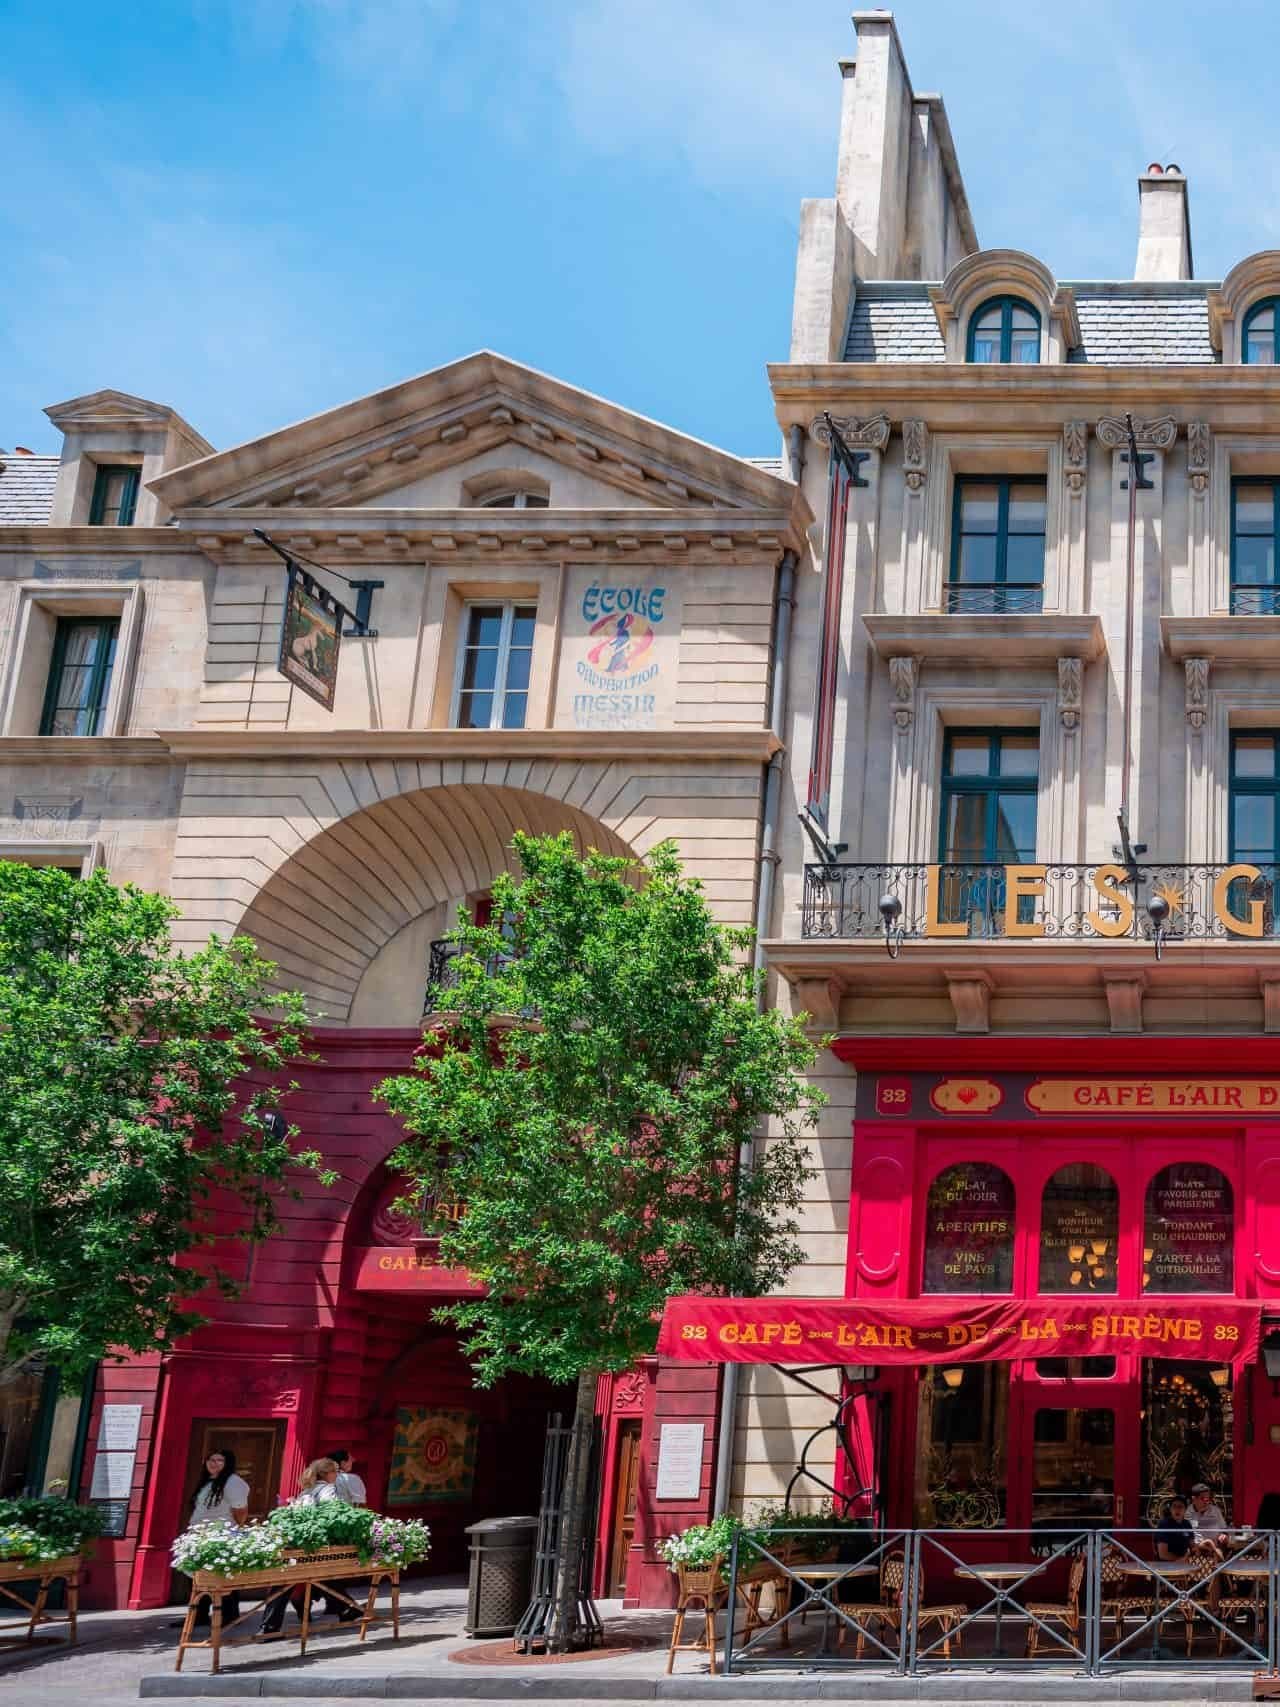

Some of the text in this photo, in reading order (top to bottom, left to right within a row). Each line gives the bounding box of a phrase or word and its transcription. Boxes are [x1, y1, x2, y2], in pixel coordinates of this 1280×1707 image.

[926, 865, 1136, 937] LES
[1073, 1083, 1153, 1106] CAFÉ
[1168, 1085, 1244, 1108] L'AIR
[1164, 1222, 1215, 1231] FONDANT
[1153, 1232, 1167, 1241] DU
[379, 1254, 433, 1271] CAFÉ
[944, 1264, 961, 1274] DE
[681, 1313, 1240, 1350] 32 CAFÉ L'AIR DE LA SIRÈNE 32
